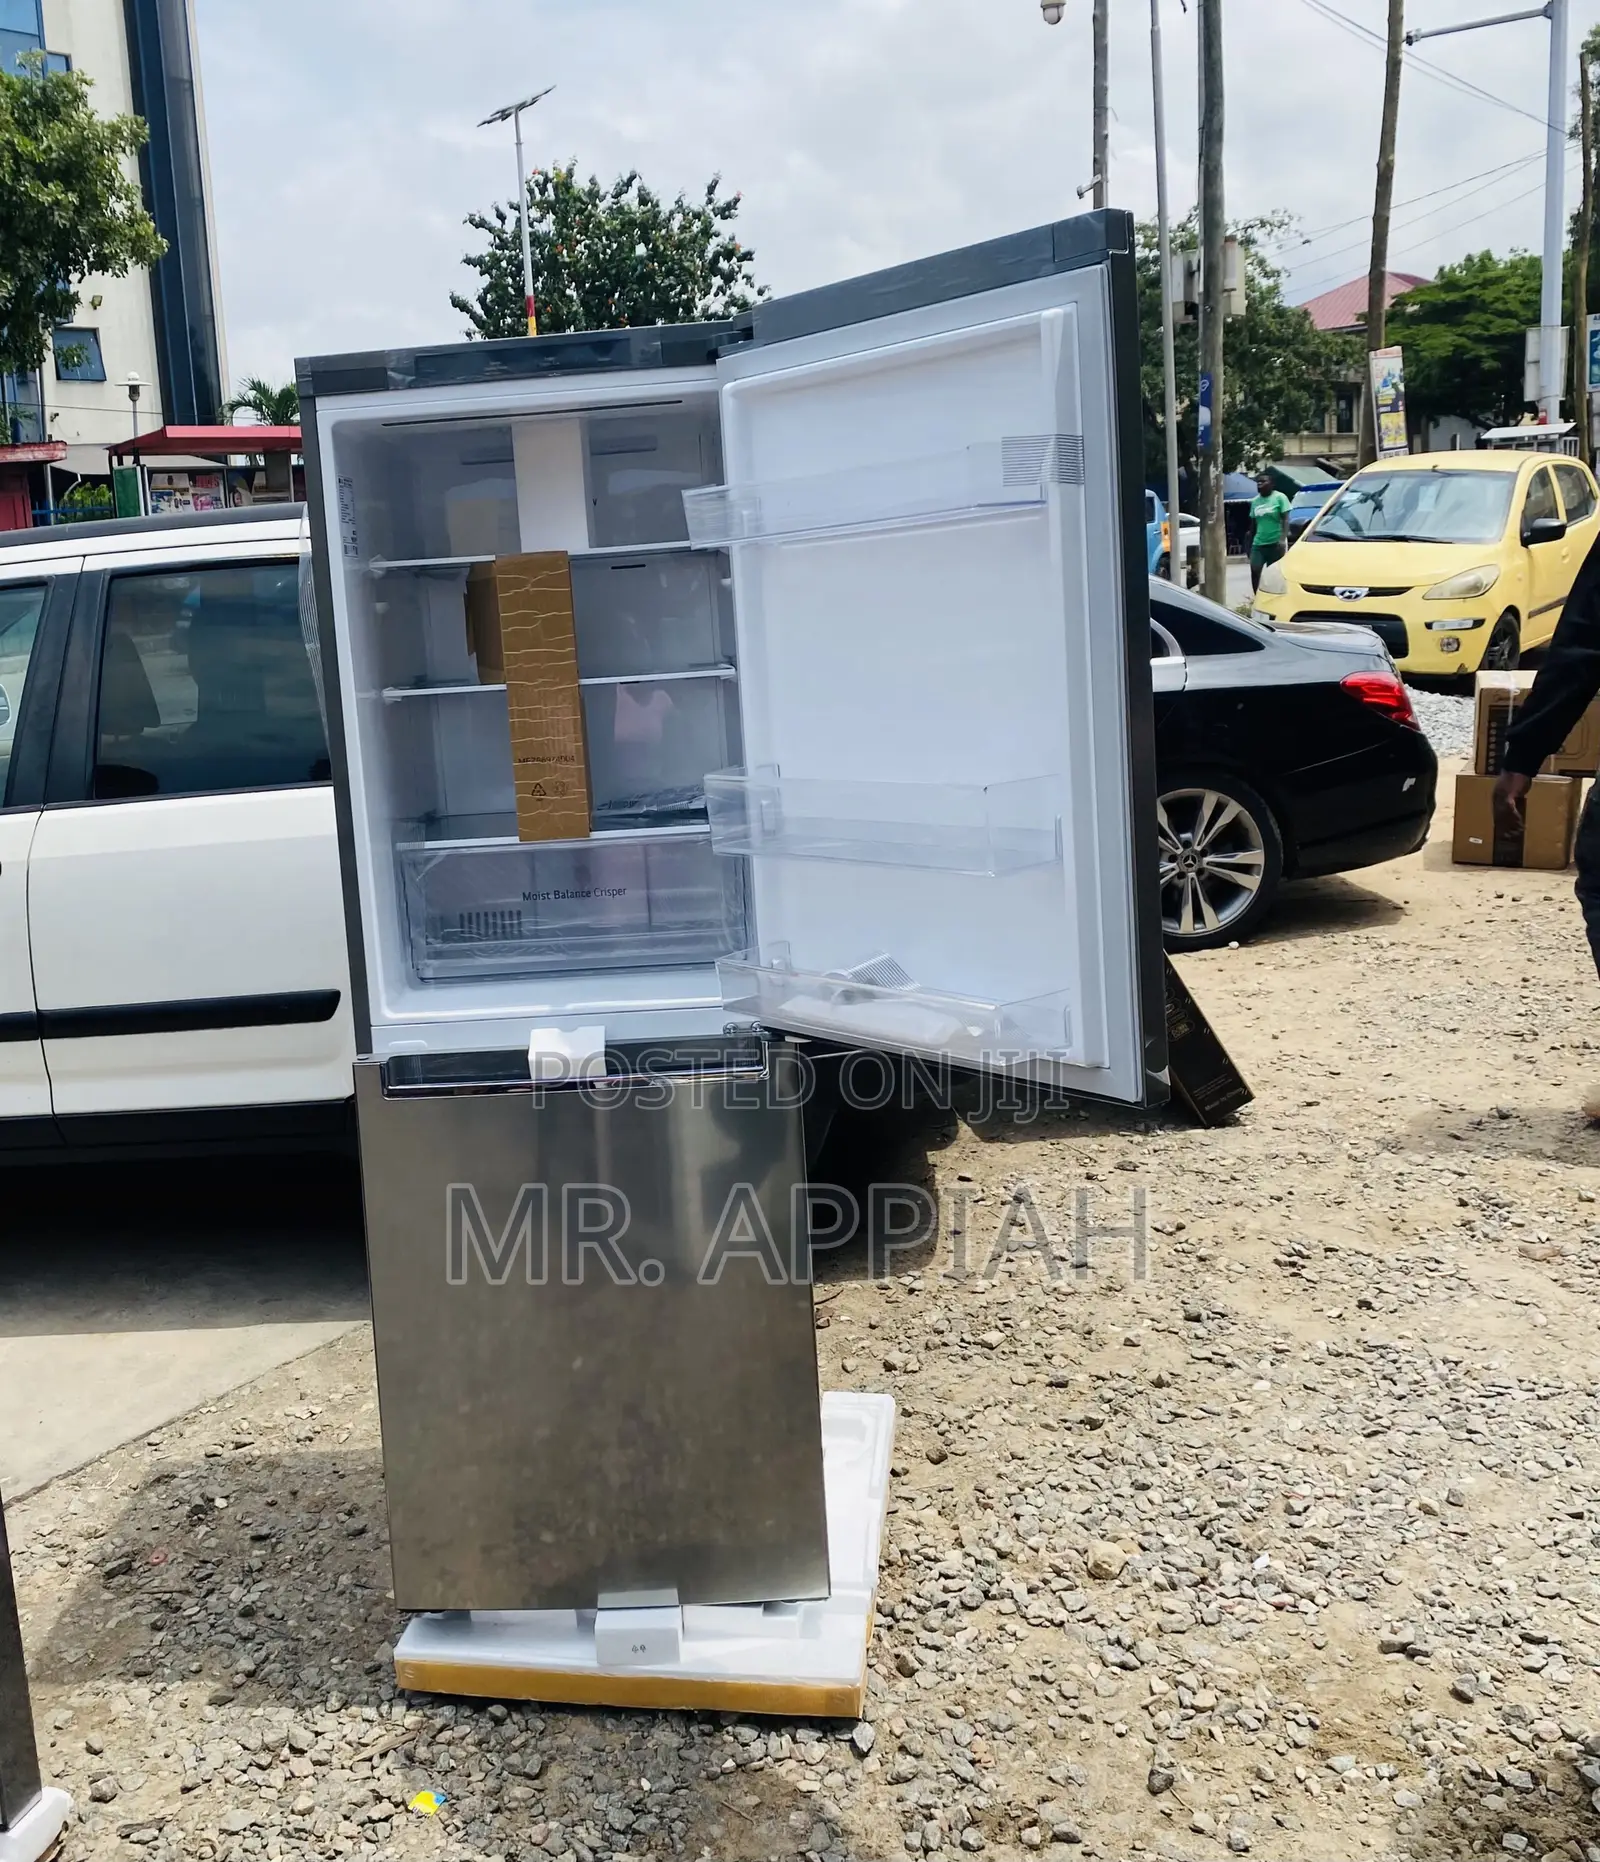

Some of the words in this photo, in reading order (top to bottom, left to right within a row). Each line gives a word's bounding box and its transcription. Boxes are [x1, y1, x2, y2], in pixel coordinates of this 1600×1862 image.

[521, 891, 552, 902] Moist
[552, 888, 592, 901] Balance
[593, 886, 627, 899] Crisper
